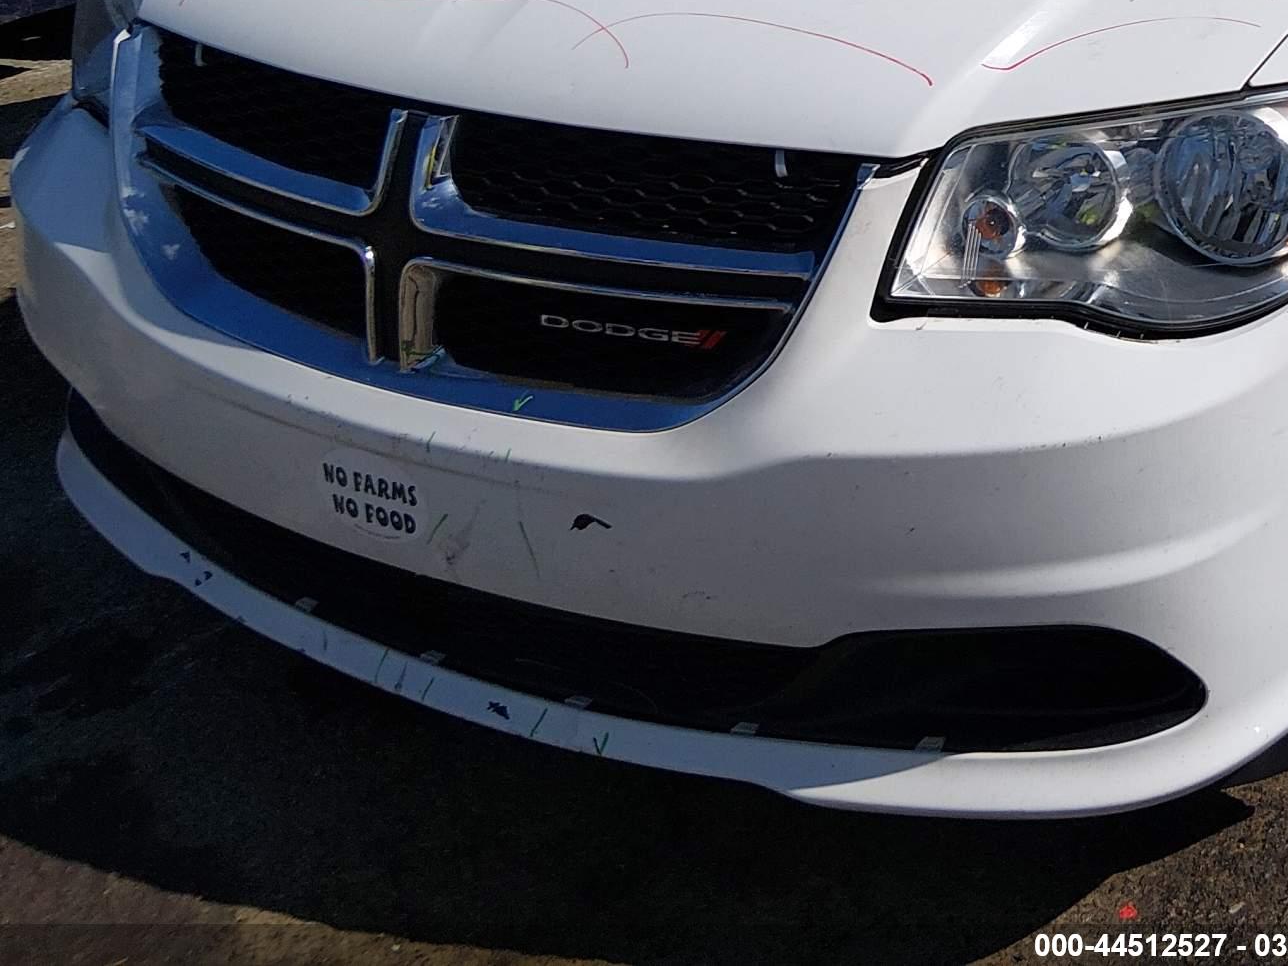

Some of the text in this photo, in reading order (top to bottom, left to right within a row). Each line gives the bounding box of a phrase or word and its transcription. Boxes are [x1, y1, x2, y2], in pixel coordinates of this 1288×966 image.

[540, 314, 701, 345] DODGE
[322, 462, 418, 507] NO FARMS
[332, 493, 416, 534] NO FOOD
